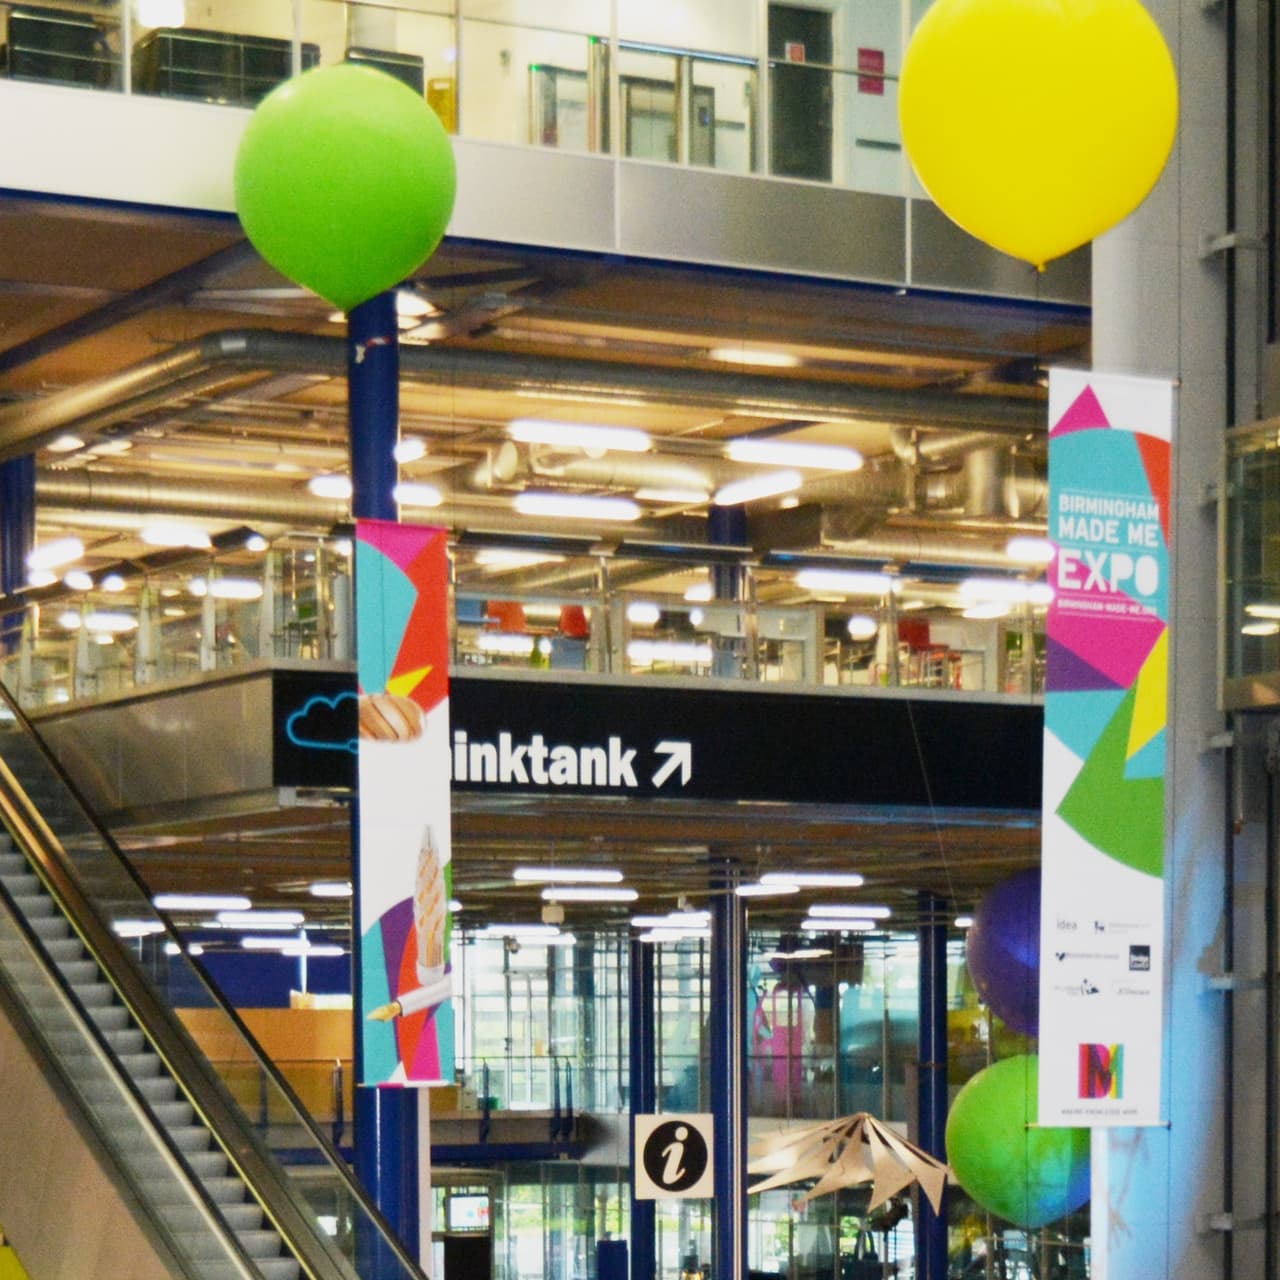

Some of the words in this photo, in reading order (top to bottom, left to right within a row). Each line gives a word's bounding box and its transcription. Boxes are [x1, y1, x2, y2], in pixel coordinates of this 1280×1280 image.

[1058, 494, 1159, 521] BIRMINGHAM
[1058, 516, 1120, 545] MADE
[1127, 522, 1159, 548] ME
[1058, 548, 1159, 596] EXPO
[450, 730, 639, 788] inktank
